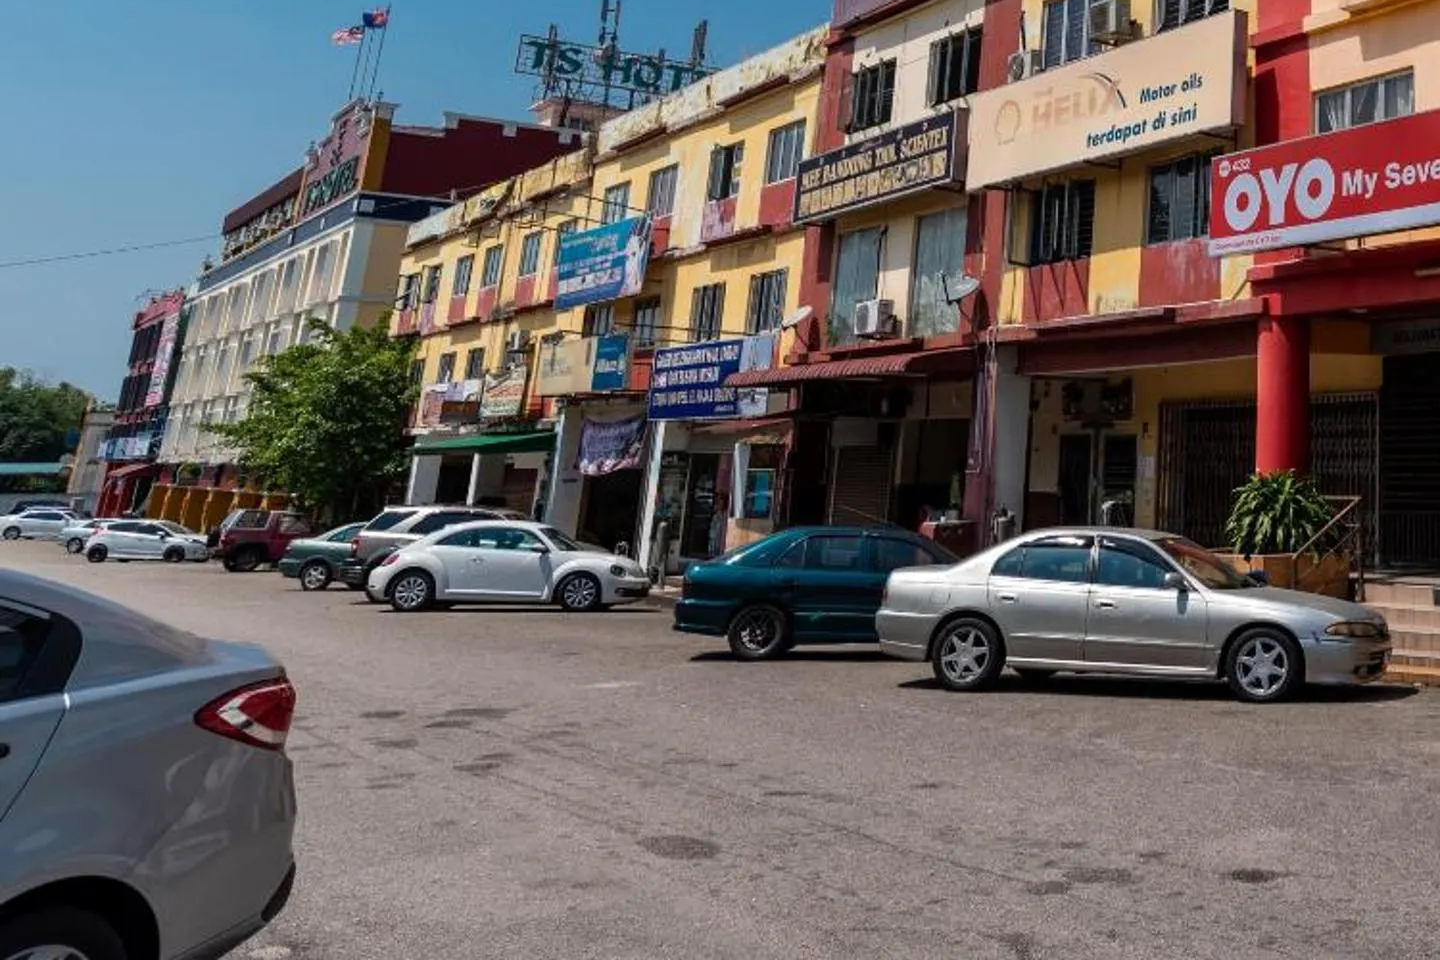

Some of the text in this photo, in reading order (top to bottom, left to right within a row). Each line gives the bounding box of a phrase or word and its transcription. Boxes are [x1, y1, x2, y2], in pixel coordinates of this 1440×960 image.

[524, 41, 712, 92] TS HOT
[1139, 73, 1204, 105] Motor oils
[1086, 103, 1198, 149] terdapat di sini
[1224, 158, 1335, 232] OYO
[1341, 168, 1379, 199] My
